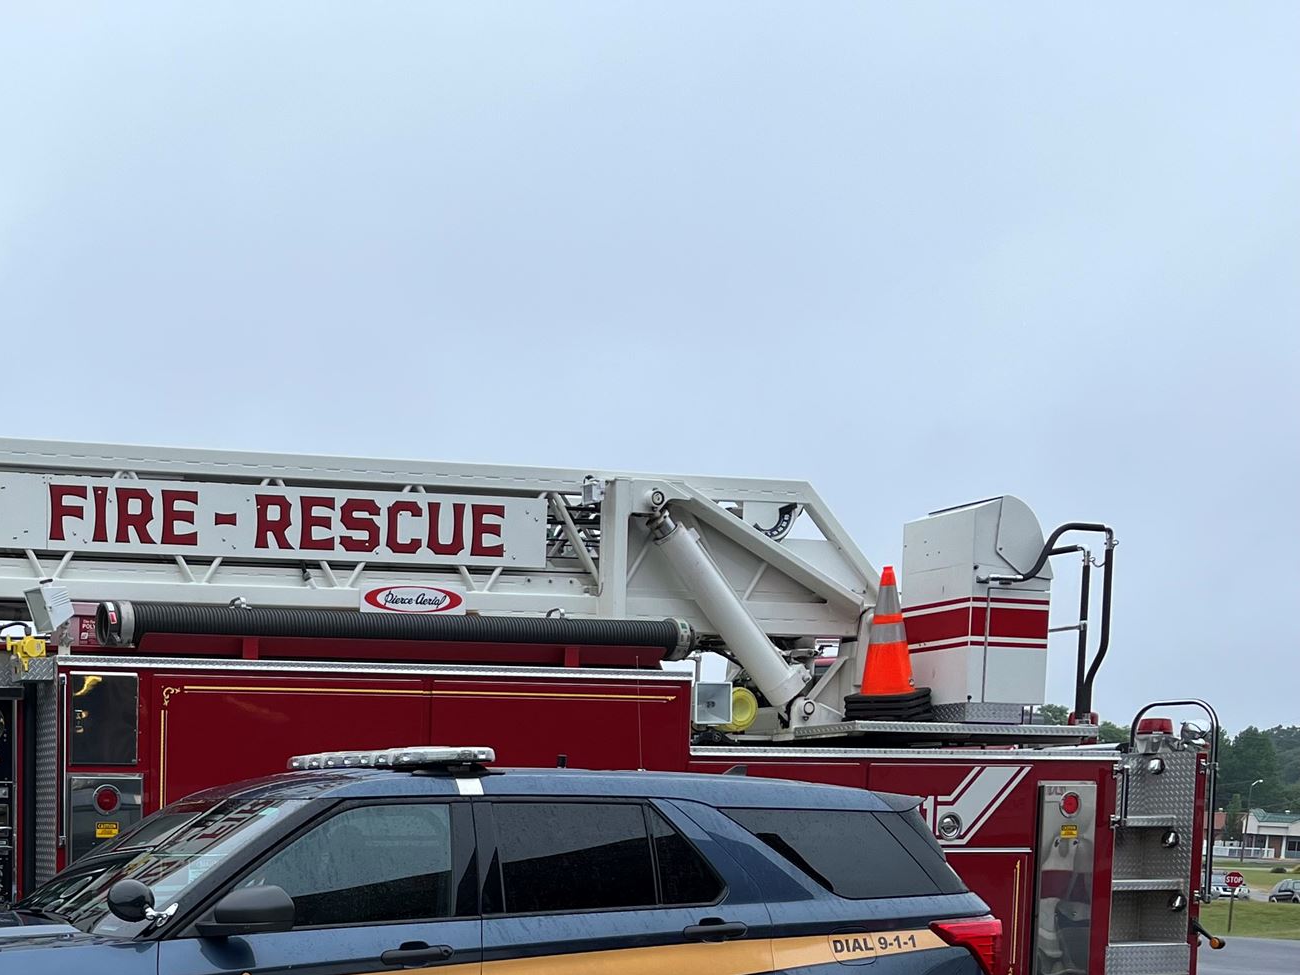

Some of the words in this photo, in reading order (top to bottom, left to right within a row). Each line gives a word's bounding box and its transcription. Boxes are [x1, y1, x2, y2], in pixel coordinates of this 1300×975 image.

[383, 590, 414, 607] Pierce
[415, 593, 448, 609] Aerial
[1225, 876, 1243, 884] STOP
[832, 937, 875, 953] DIAL
[877, 934, 917, 950] 9-1-1
